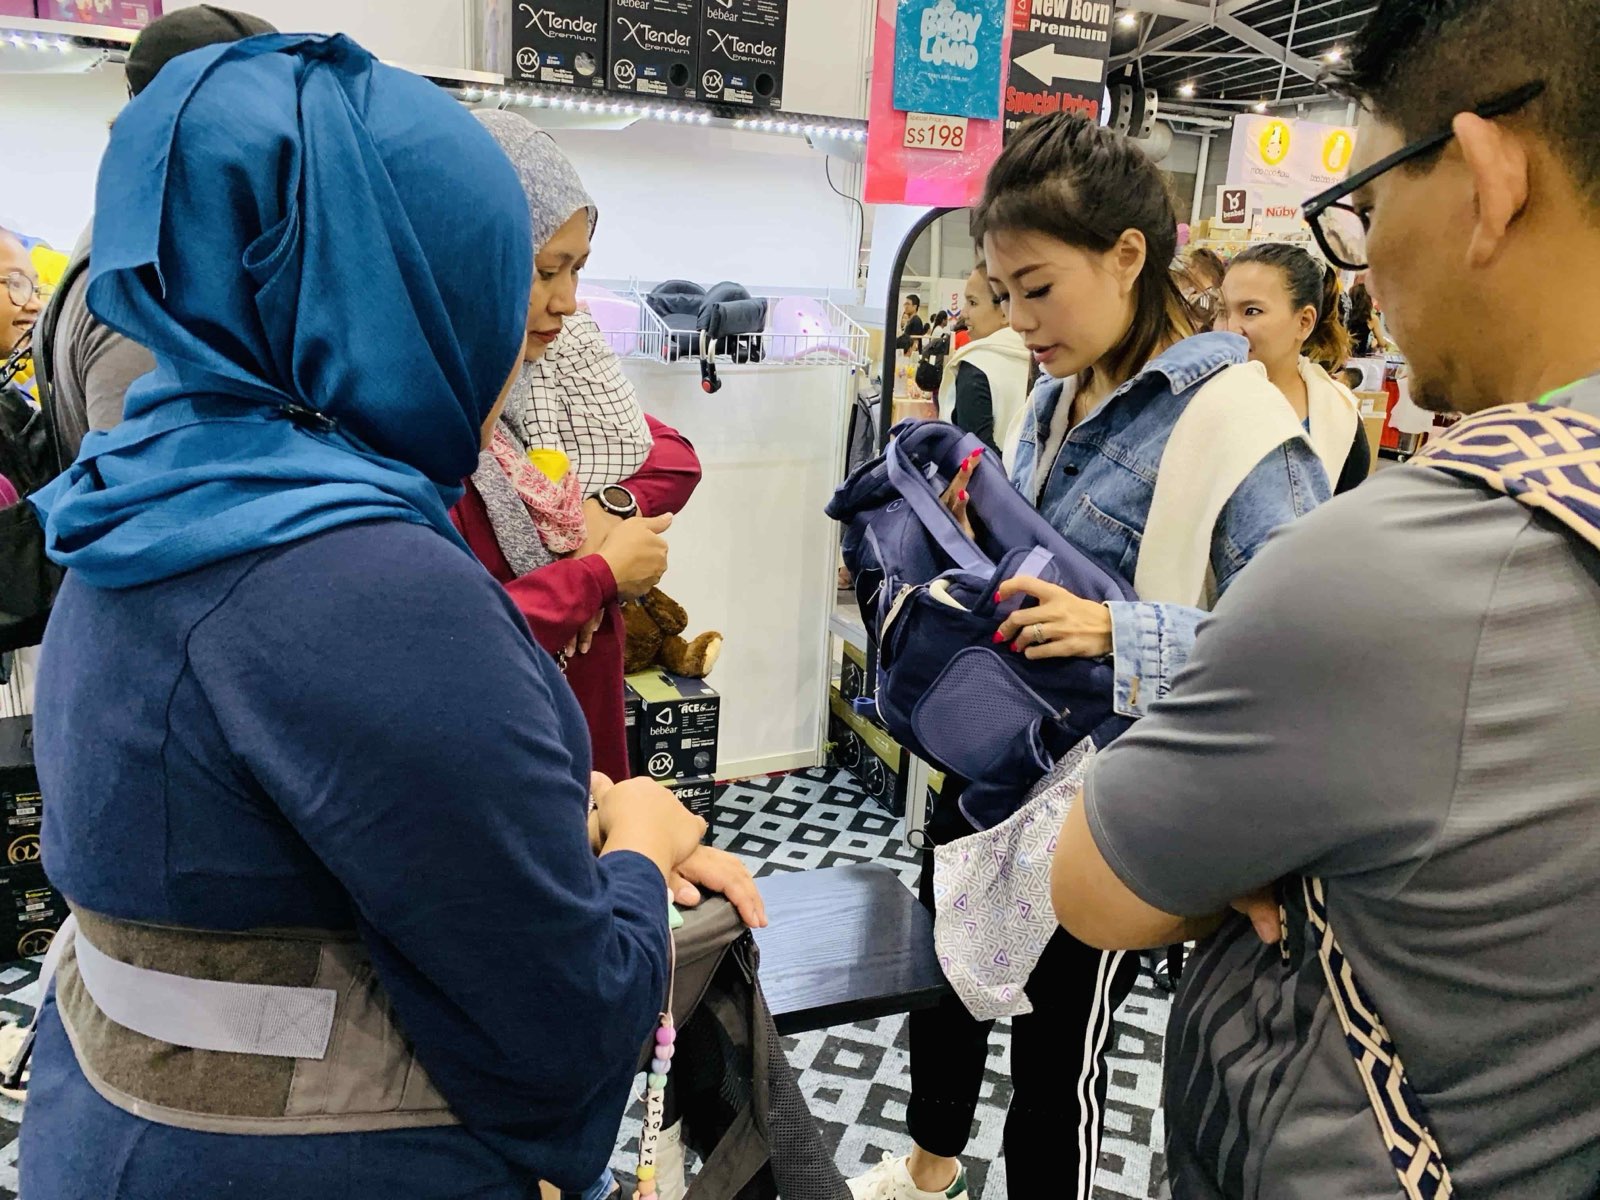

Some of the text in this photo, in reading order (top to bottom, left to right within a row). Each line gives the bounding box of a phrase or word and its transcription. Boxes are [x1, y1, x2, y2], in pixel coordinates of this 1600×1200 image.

[1031, 0, 1110, 25] New Born
[548, 30, 597, 42] Premium
[921, 6, 983, 44] BABY
[1029, 18, 1108, 42] Premium
[644, 43, 690, 55] Premium
[732, 54, 776, 65] Premium
[920, 36, 979, 70] LAND
[1006, 86, 1099, 120] Special Price
[906, 124, 964, 147] S$198
[681, 703, 700, 714] ACE
